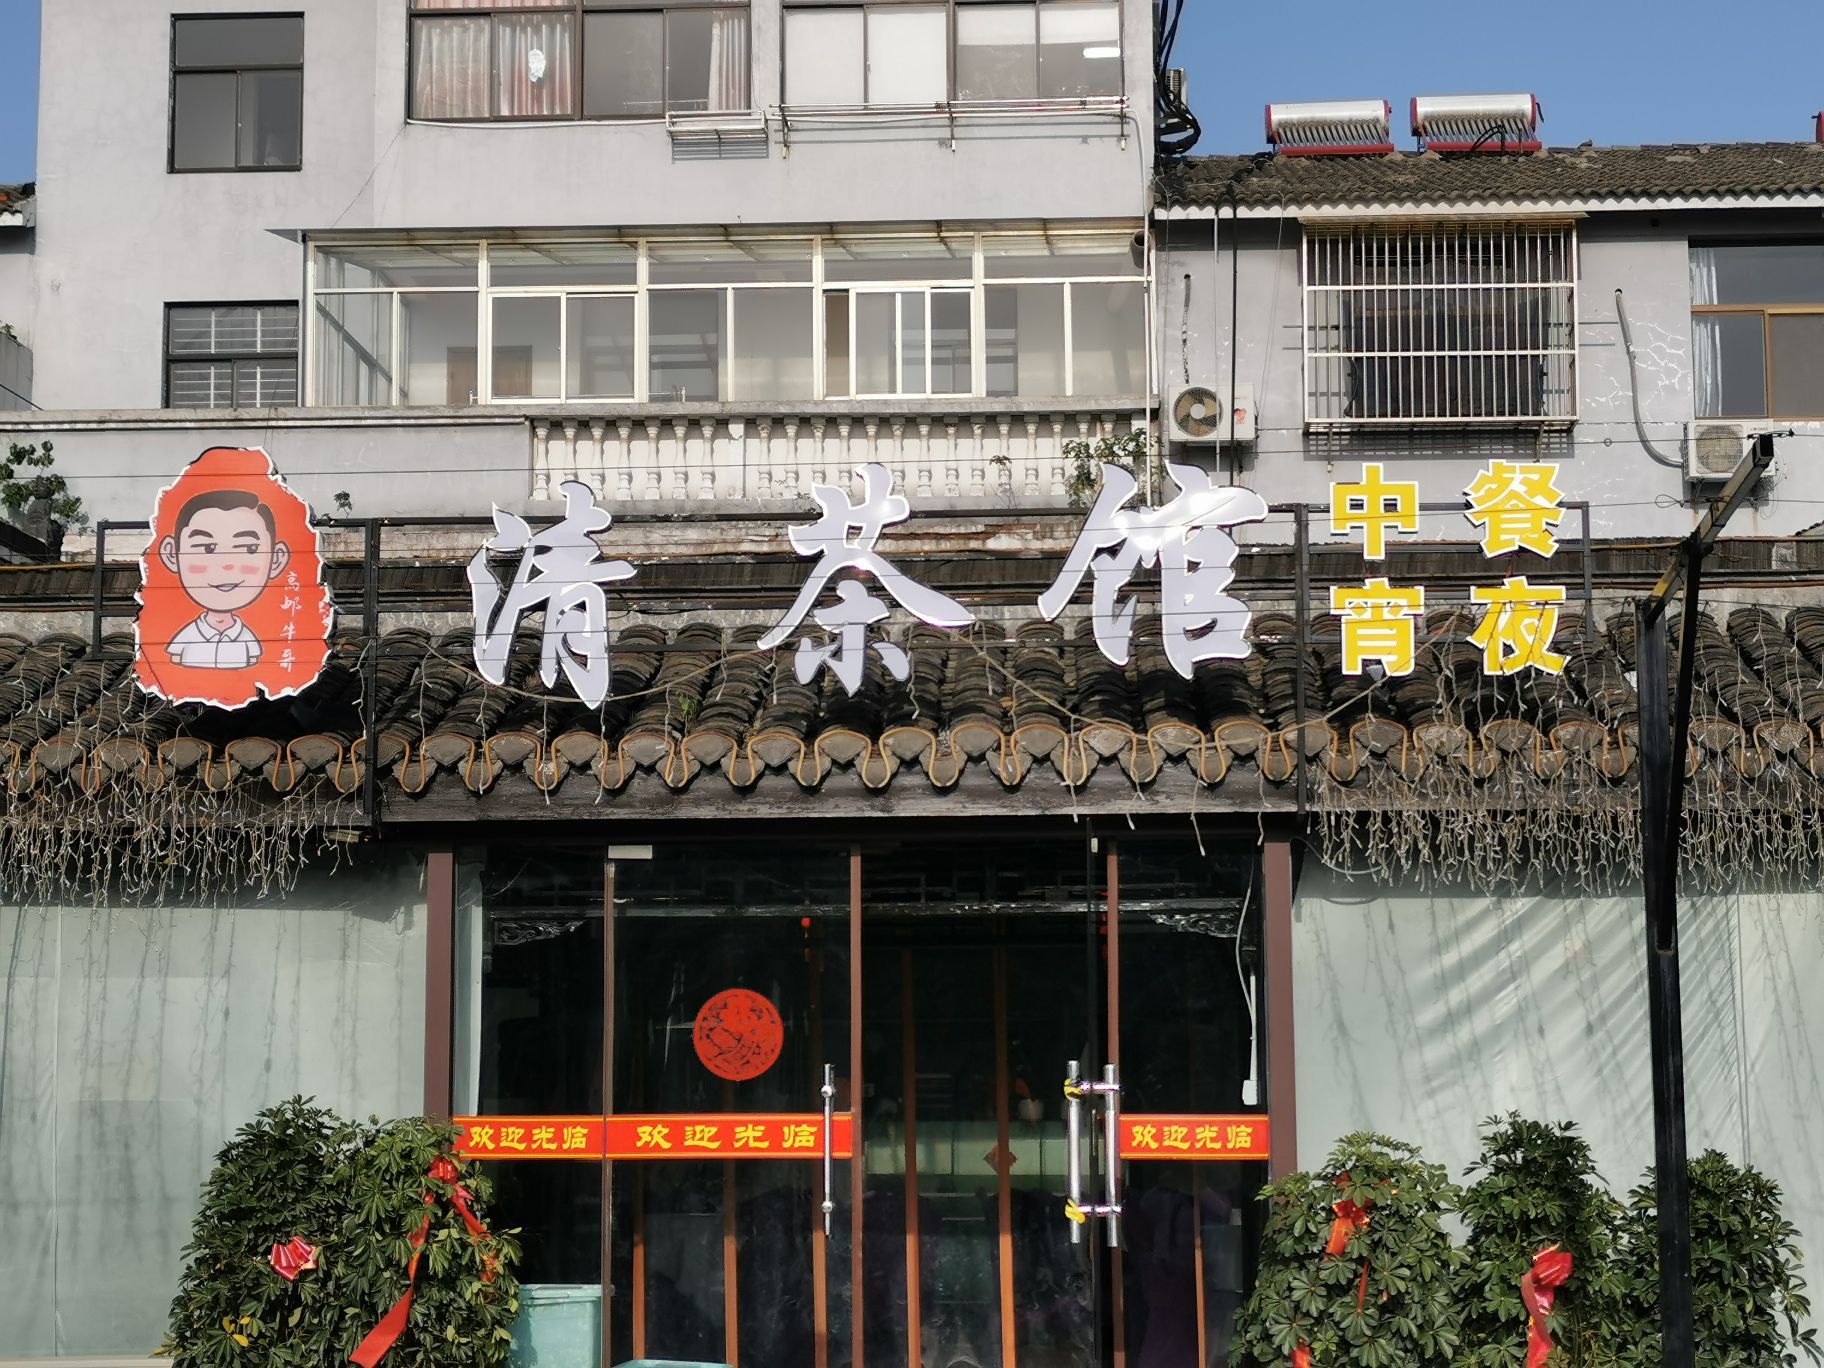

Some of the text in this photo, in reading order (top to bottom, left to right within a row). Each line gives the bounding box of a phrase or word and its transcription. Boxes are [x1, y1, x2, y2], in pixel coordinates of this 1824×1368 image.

[1330, 459, 1566, 559] 中餐
[467, 462, 1269, 710] 清茶馆
[1330, 576, 1571, 676] 宵夜
[469, 1126, 588, 1150] 欢迎光临
[635, 1124, 819, 1150] 欢迎光临
[1131, 1124, 1253, 1150] 欢迎光临
